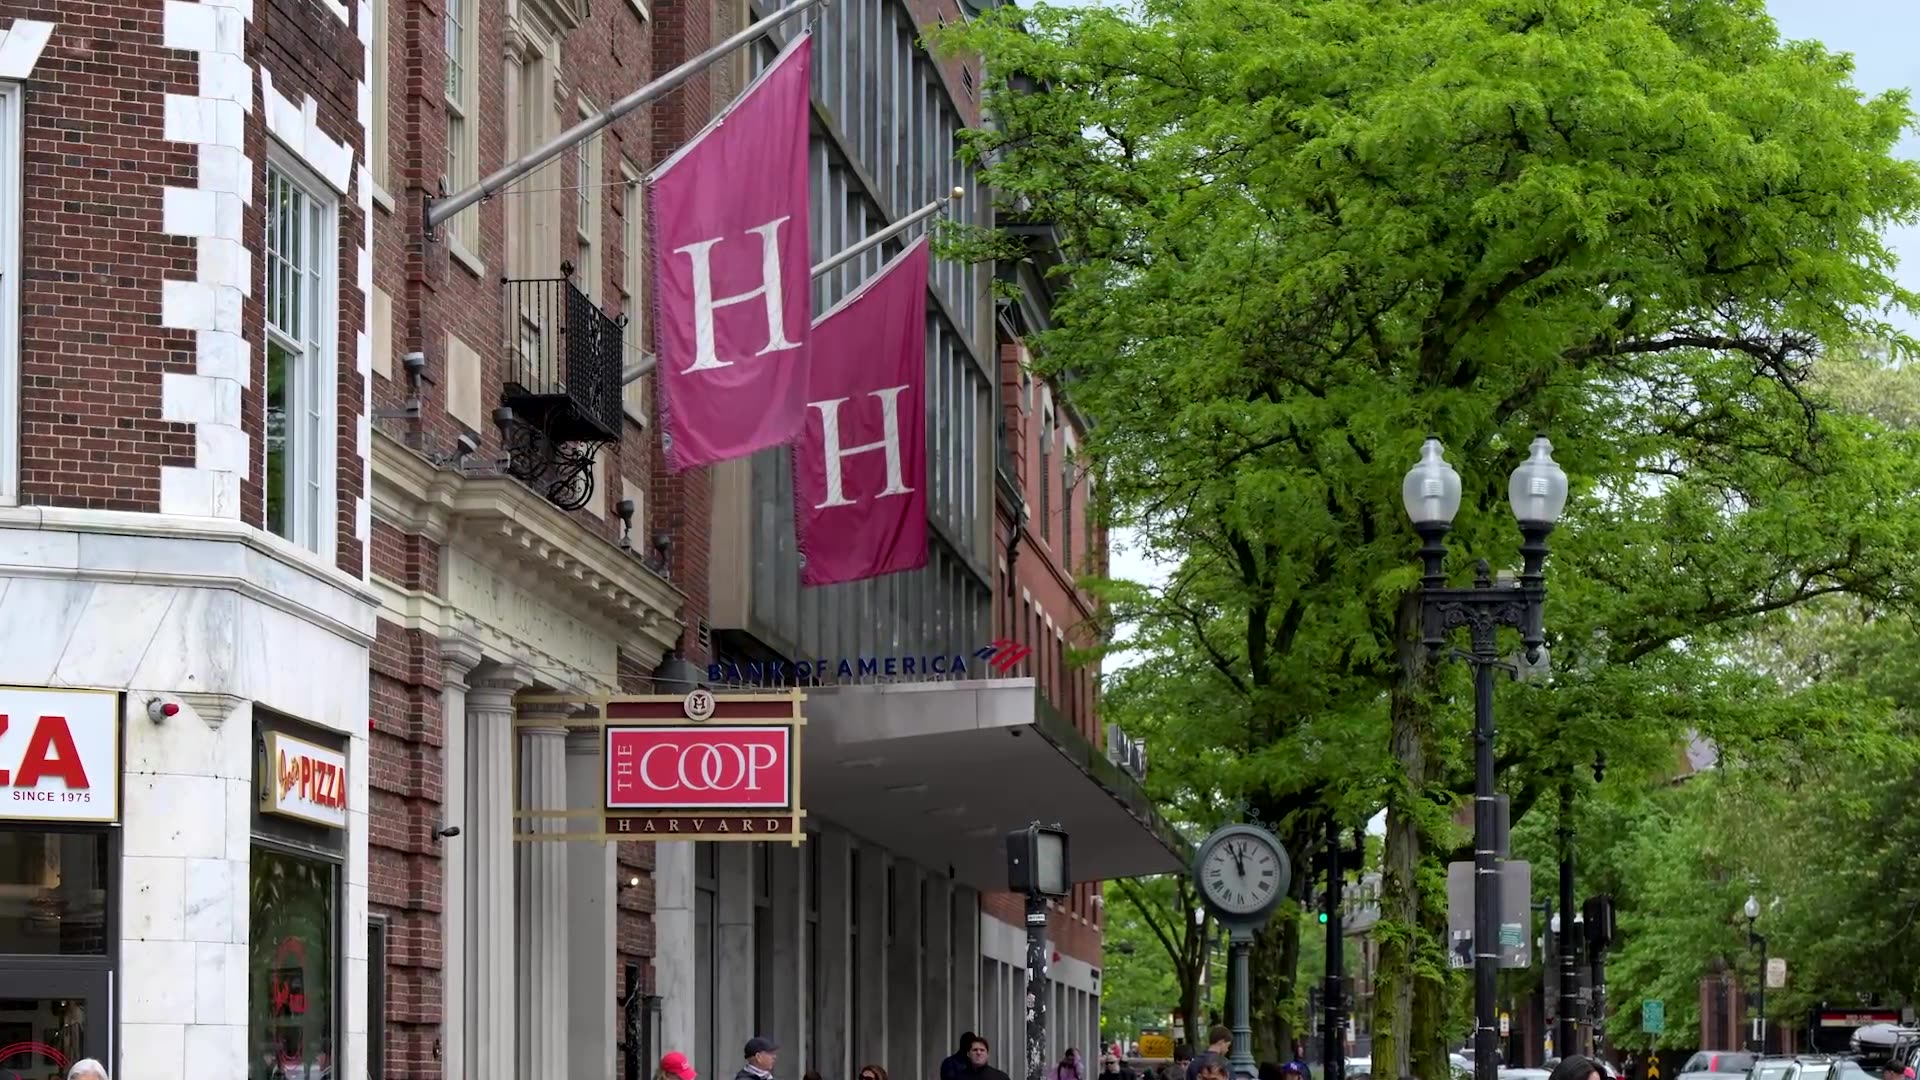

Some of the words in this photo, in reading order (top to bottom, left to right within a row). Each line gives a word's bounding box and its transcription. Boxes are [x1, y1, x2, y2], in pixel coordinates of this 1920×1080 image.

[674, 215, 802, 375] H
[807, 385, 915, 510] H
[708, 660, 785, 682] BANK
[796, 659, 827, 679] OF
[837, 655, 968, 677] AMERICA
[0, 714, 90, 789] A
[617, 744, 632, 792] THE
[640, 743, 777, 791] COOP
[13, 791, 55, 801] SINCE
[61, 793, 91, 802] 1975
[301, 756, 346, 811] PIZZA
[618, 819, 779, 832] HARVARD
